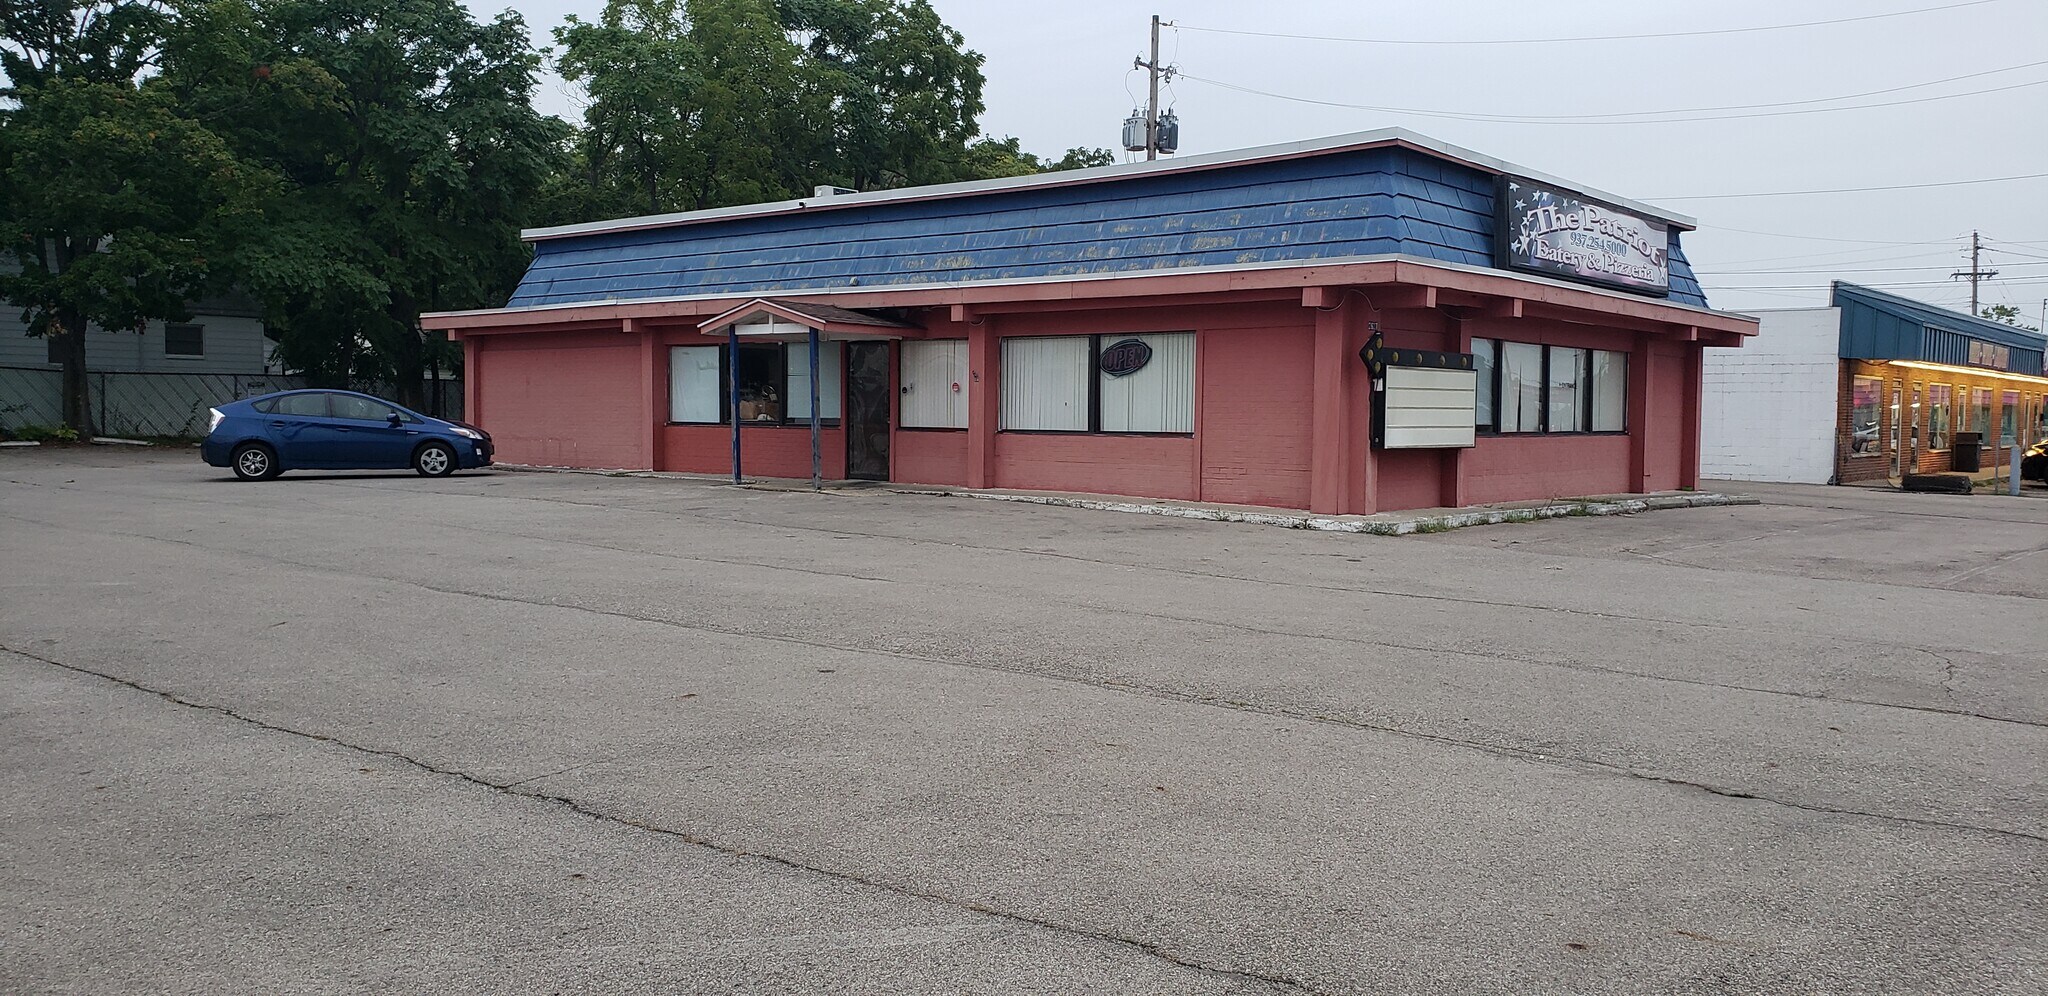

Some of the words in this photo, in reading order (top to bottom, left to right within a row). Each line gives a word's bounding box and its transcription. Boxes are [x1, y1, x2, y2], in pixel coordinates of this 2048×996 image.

[1527, 204, 1580, 236] The
[1580, 204, 1660, 265] Patriot
[1535, 239, 1587, 272] Eatery
[1586, 254, 1602, 271] &
[1602, 254, 1655, 282] Pizzeria
[1104, 346, 1144, 370] OPEN
